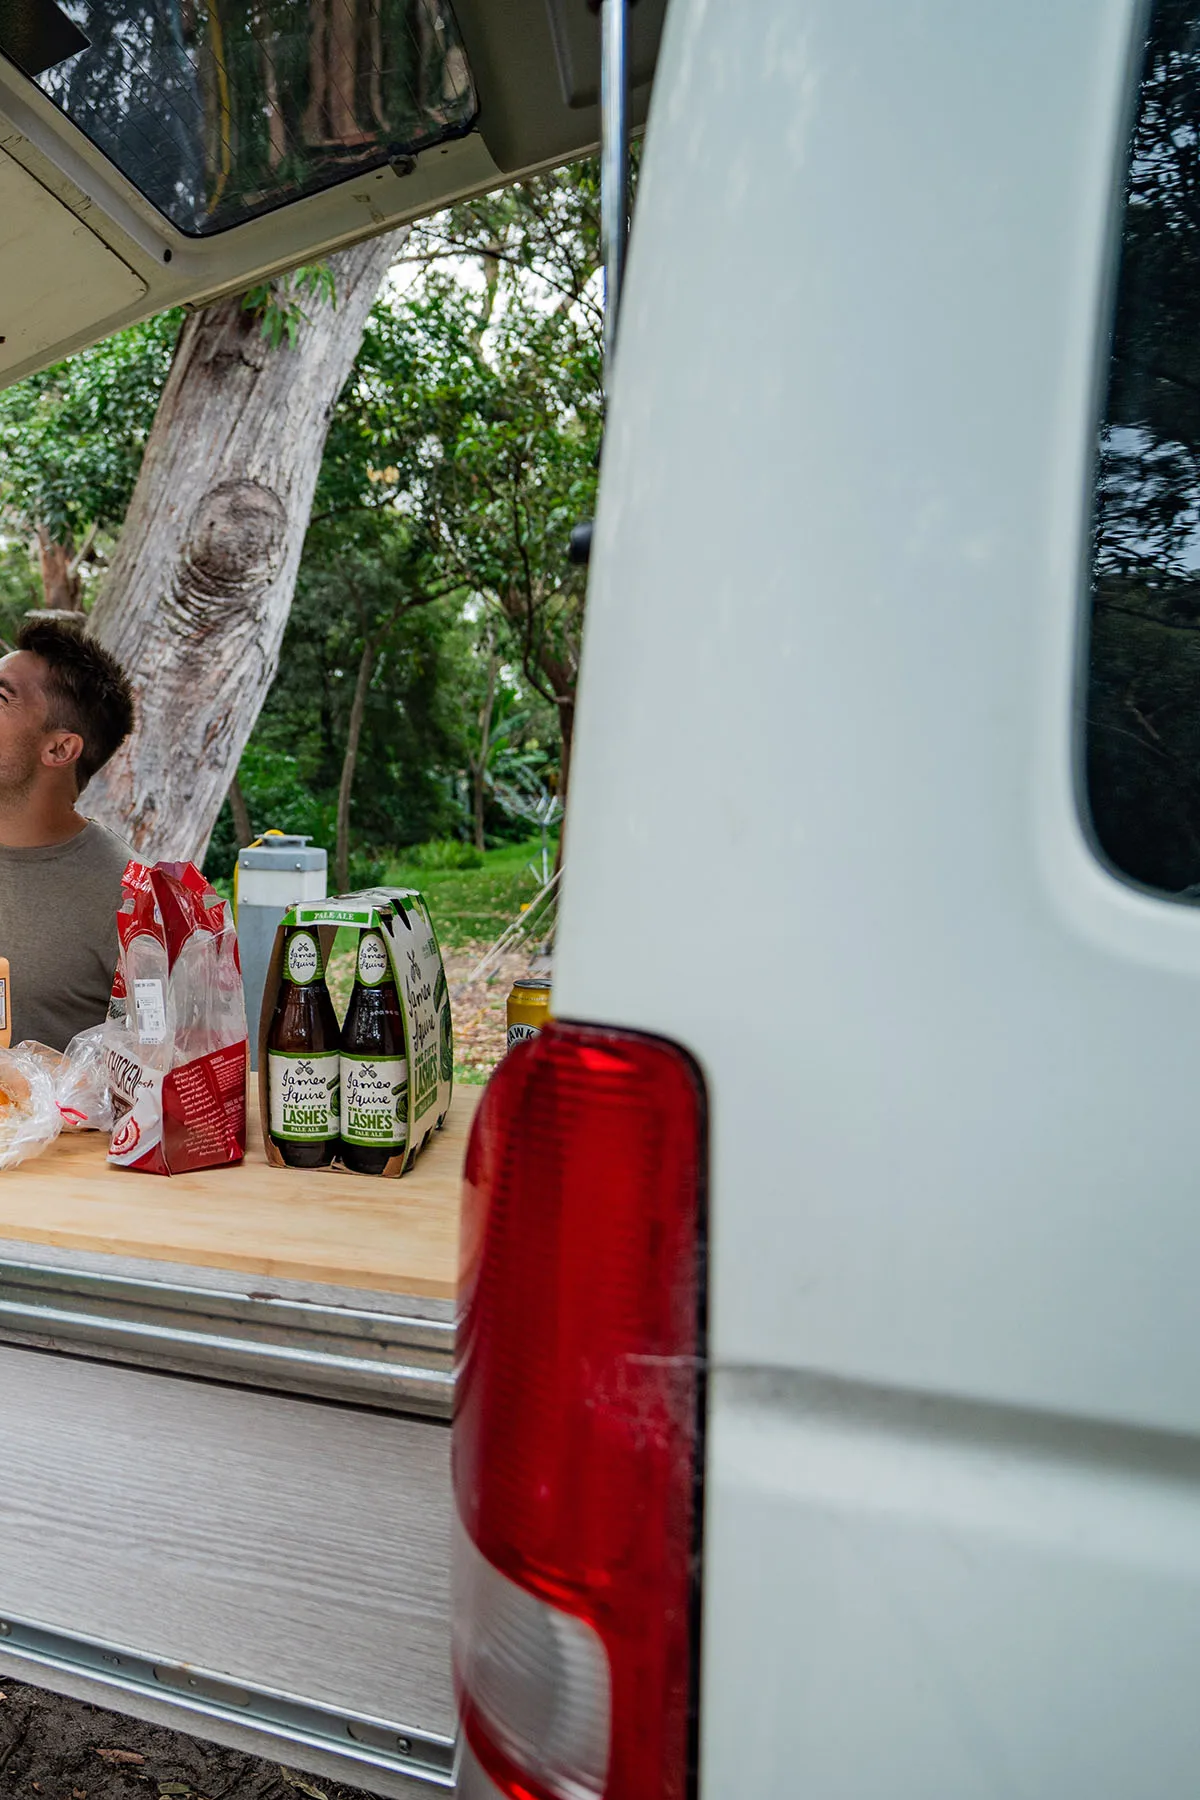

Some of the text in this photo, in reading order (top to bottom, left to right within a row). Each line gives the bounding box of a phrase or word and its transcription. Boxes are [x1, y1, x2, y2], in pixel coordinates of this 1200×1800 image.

[314, 911, 355, 920] PALE ALE
[290, 948, 316, 960] James
[360, 948, 386, 960] James
[281, 1068, 326, 1087] James
[347, 1071, 391, 1089] James
[281, 1085, 326, 1103] Squire
[347, 1088, 391, 1106] Squire
[283, 1109, 328, 1125] LASHES
[348, 1112, 393, 1129] LASHES
